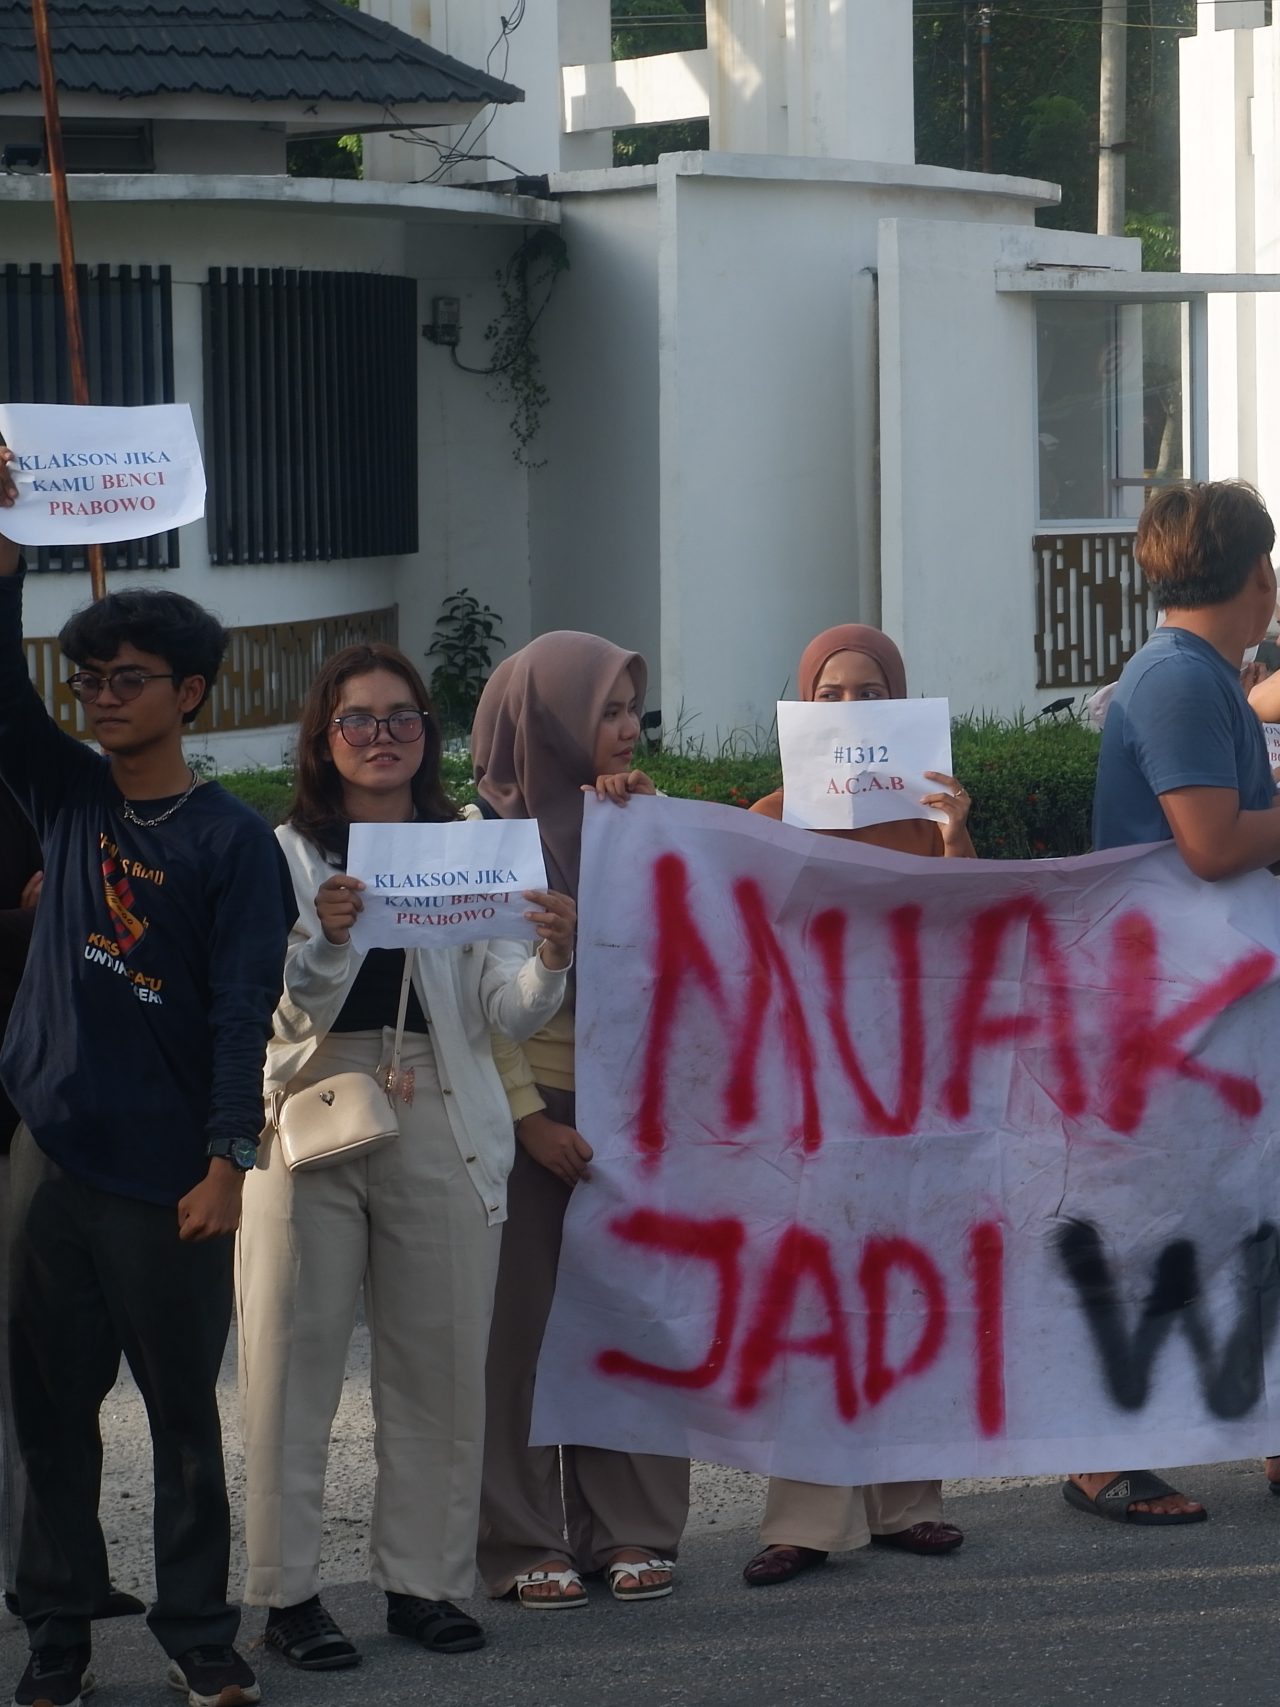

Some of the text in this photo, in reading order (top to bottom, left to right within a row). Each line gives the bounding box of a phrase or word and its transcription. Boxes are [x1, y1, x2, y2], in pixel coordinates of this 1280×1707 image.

[18, 450, 171, 471] KLAKSON JIKA
[32, 471, 165, 492] KAMU BENCI
[49, 495, 156, 516] PRABOWO
[834, 746, 889, 764] #1312
[827, 776, 905, 794] A.C.A.B
[375, 869, 518, 888] KLAKSON JIKA
[385, 892, 510, 908] KAMU BENCI
[396, 907, 496, 926] PRABOWO
[634, 850, 1278, 1180] MUAK
[596, 1205, 1006, 1440] JADI
